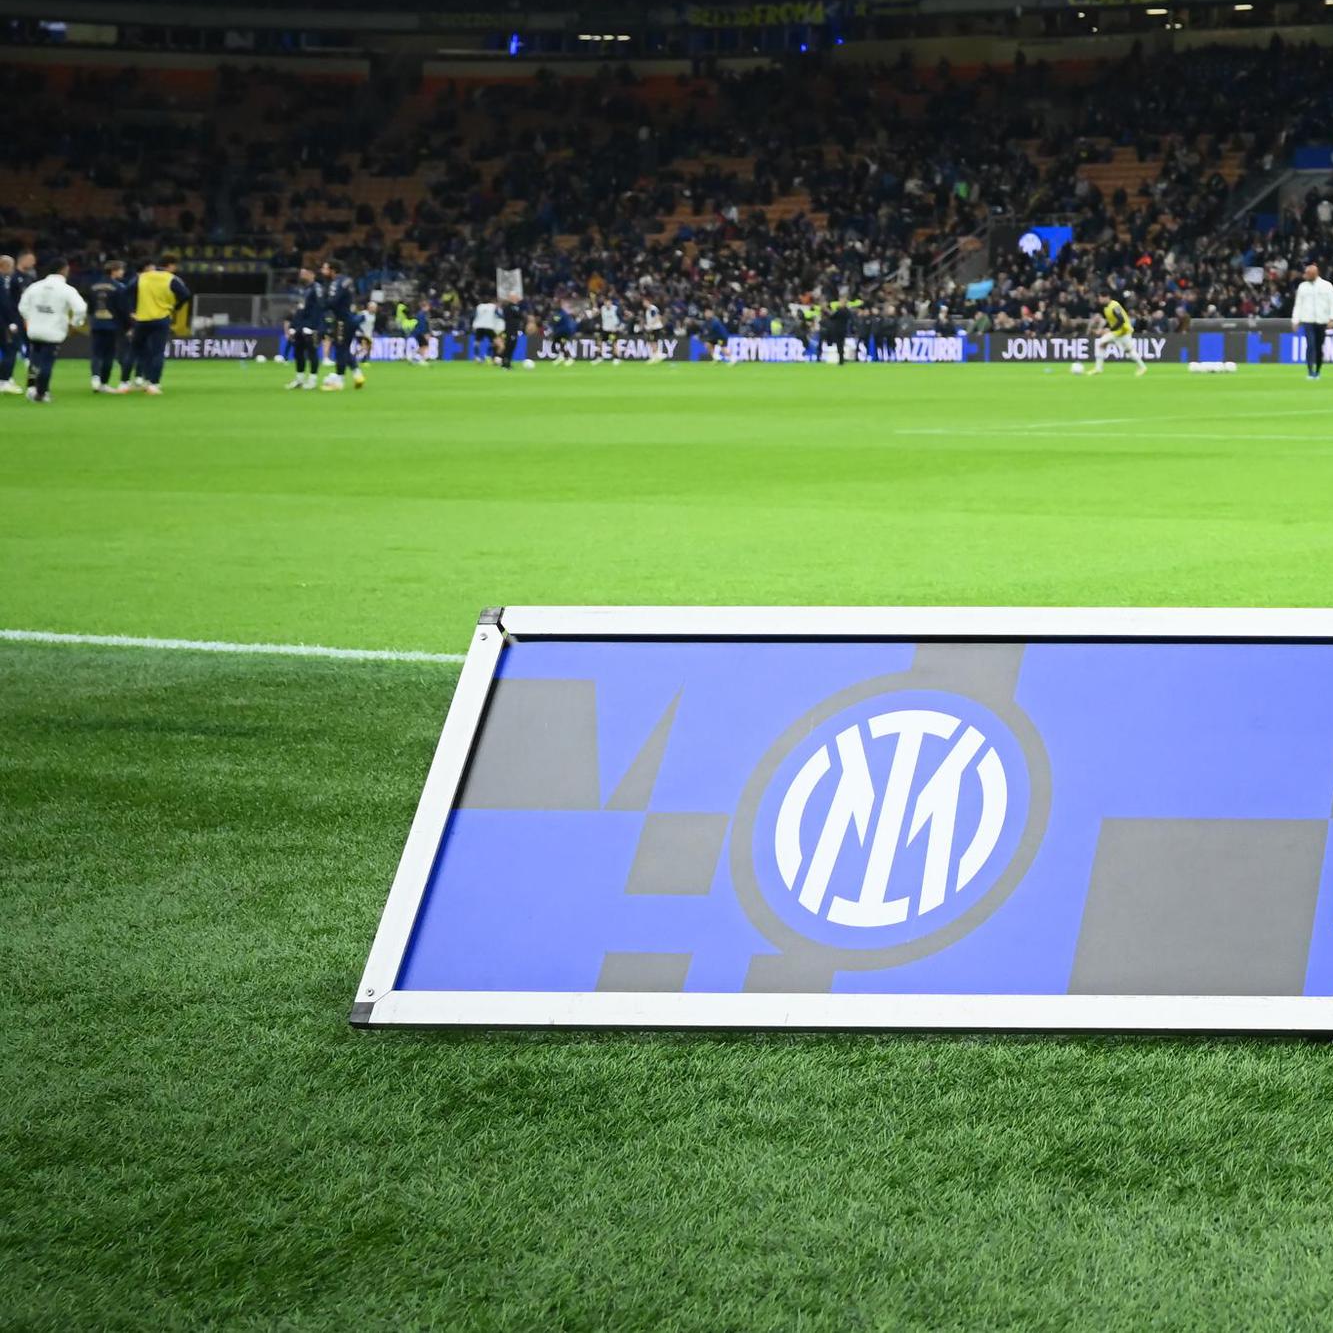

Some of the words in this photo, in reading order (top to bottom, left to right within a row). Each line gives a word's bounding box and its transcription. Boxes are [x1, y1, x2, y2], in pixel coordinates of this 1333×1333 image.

[172, 338, 202, 358] THE
[203, 338, 258, 358] FAMILY
[1002, 337, 1047, 360] JOIN
[1050, 337, 1090, 360] THE
